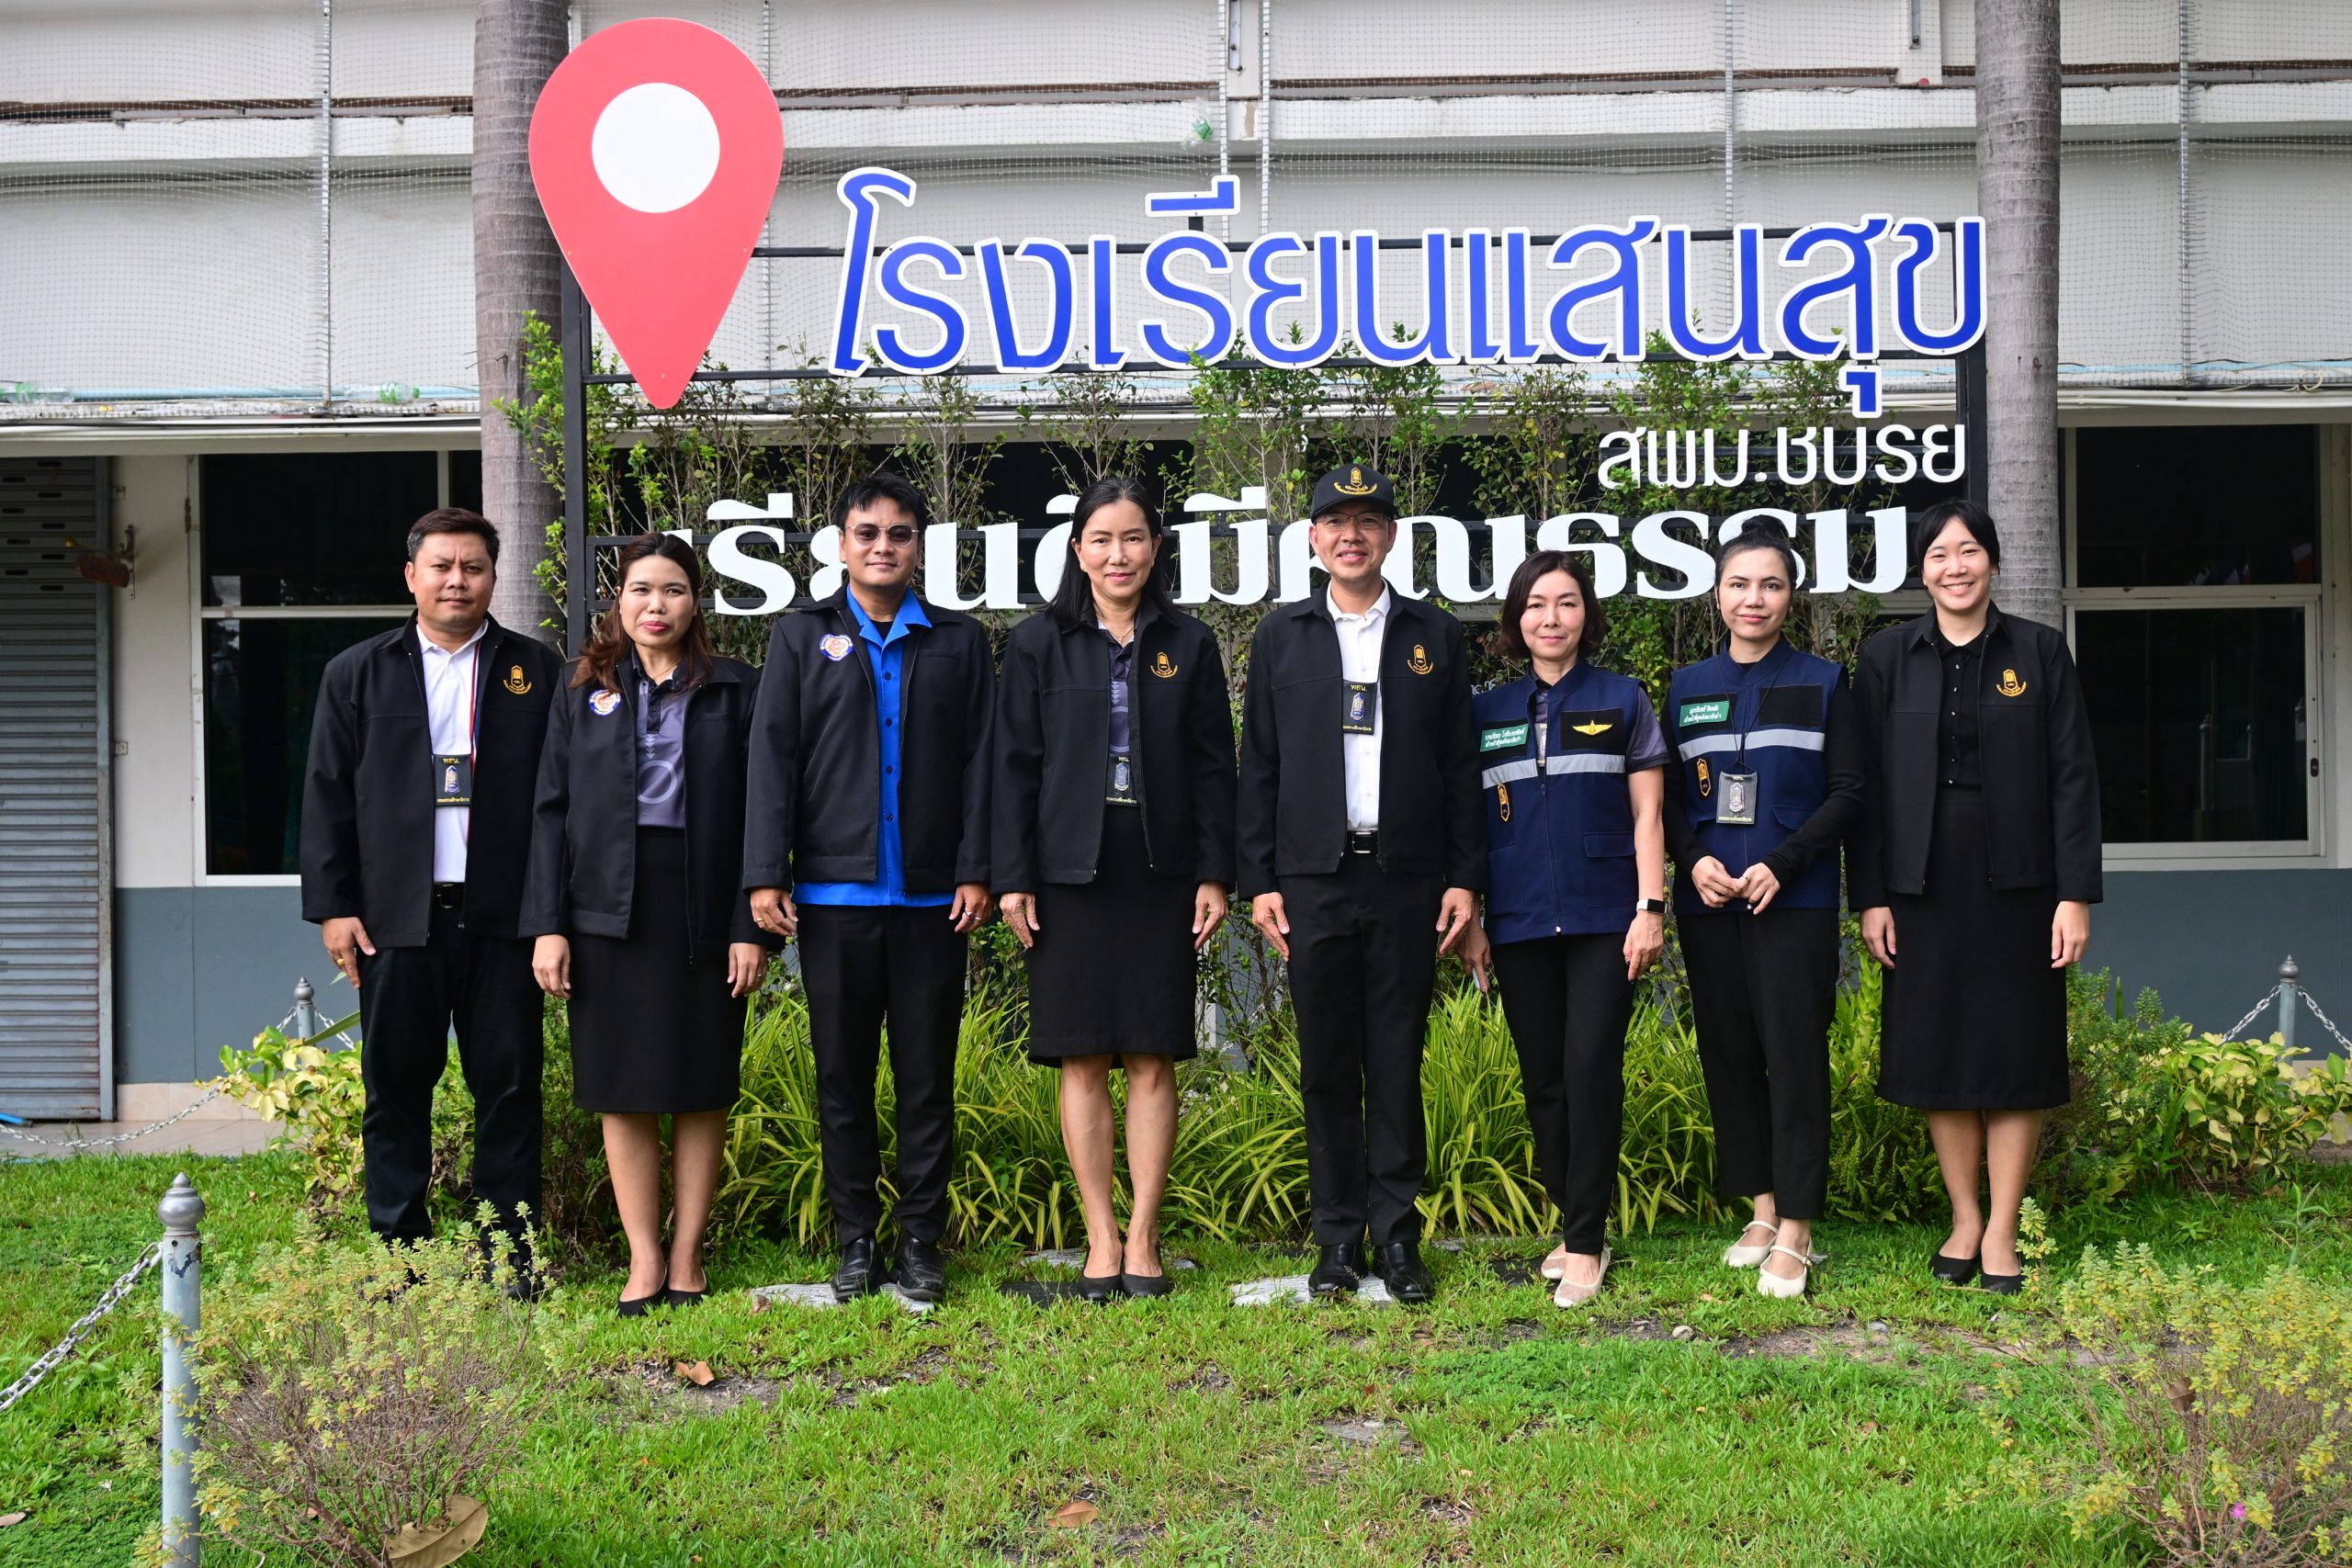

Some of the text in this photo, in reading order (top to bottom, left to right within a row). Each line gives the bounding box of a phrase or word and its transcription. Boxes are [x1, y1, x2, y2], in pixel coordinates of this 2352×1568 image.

[830, 167, 1986, 419] โรงเรียนแสนสุข
[1598, 423, 1965, 490] สพม.ชบรย
